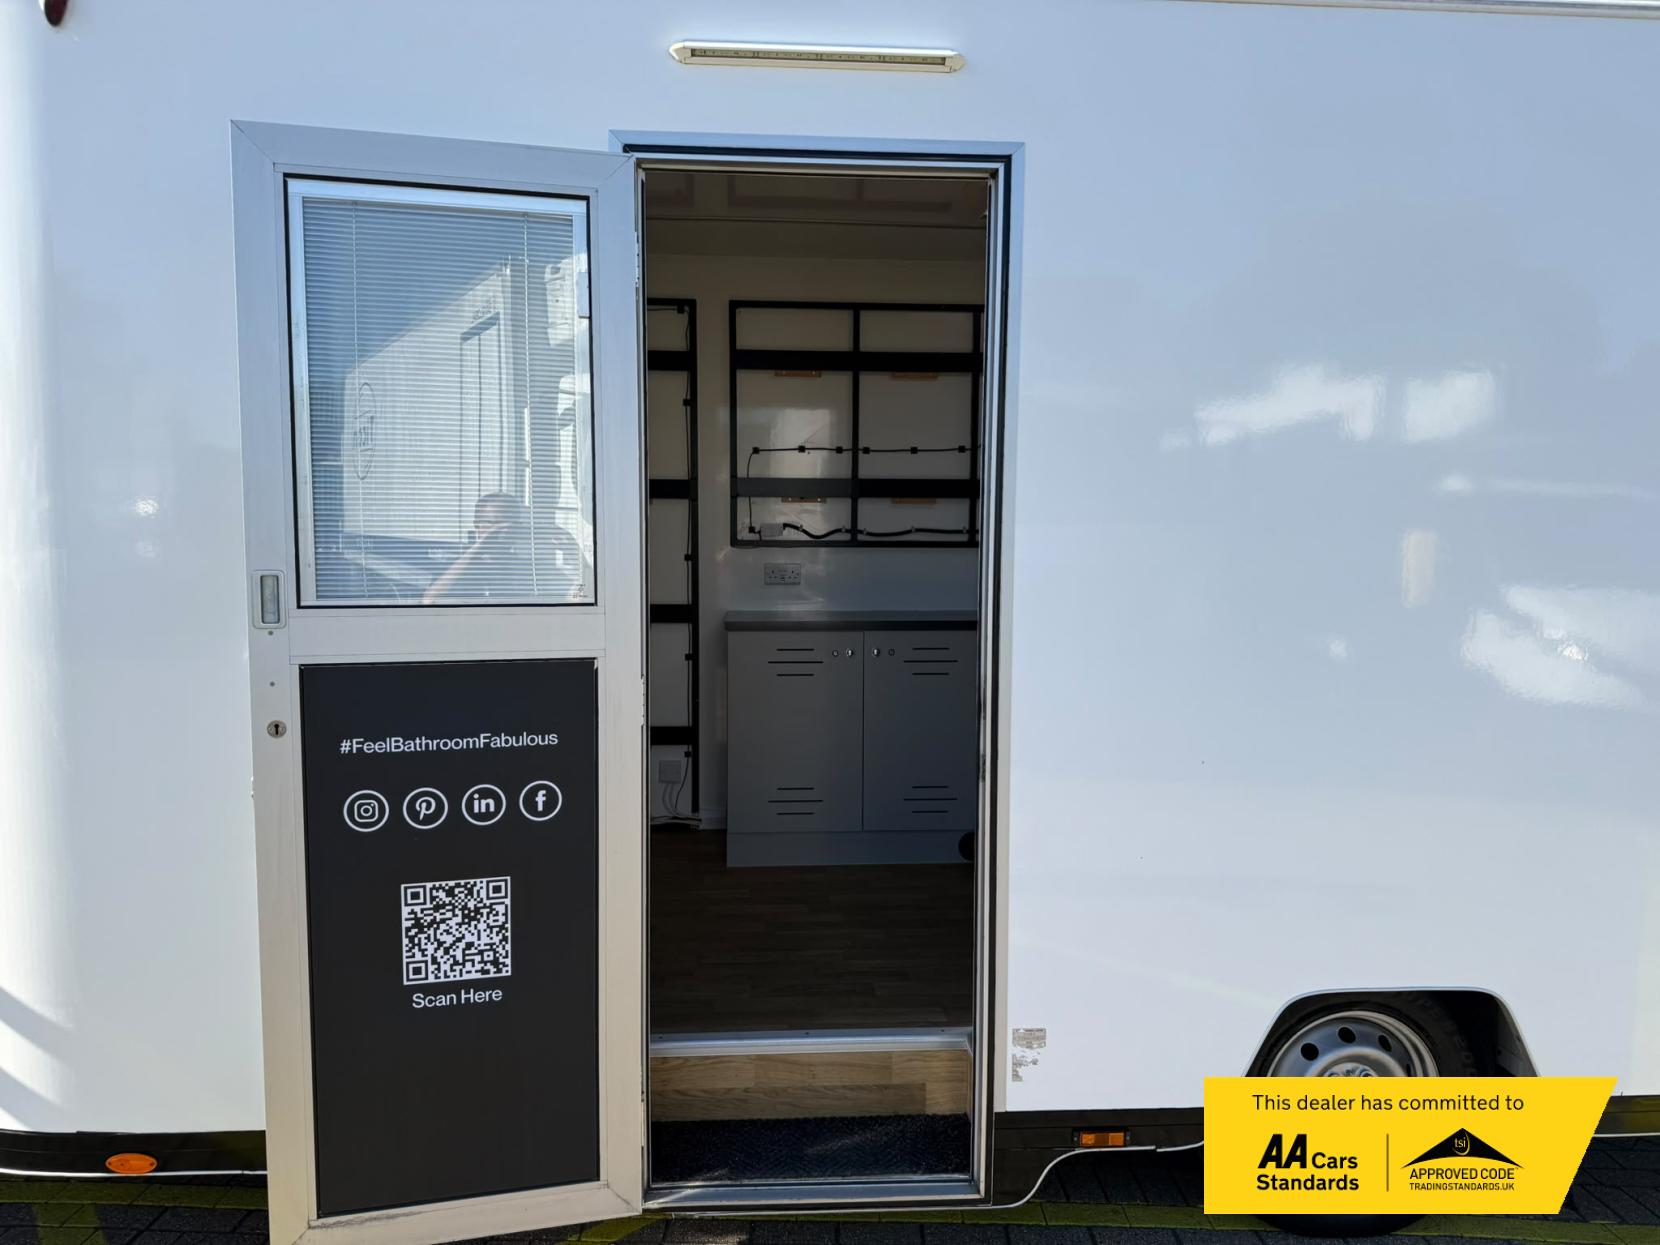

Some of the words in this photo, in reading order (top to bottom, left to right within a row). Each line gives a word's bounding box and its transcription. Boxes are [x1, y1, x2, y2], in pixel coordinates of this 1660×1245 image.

[339, 732, 559, 754] #FeelBathroomFabulous
[473, 793, 495, 813] in
[412, 992, 456, 1008] Scan
[461, 988, 503, 1004] Here
